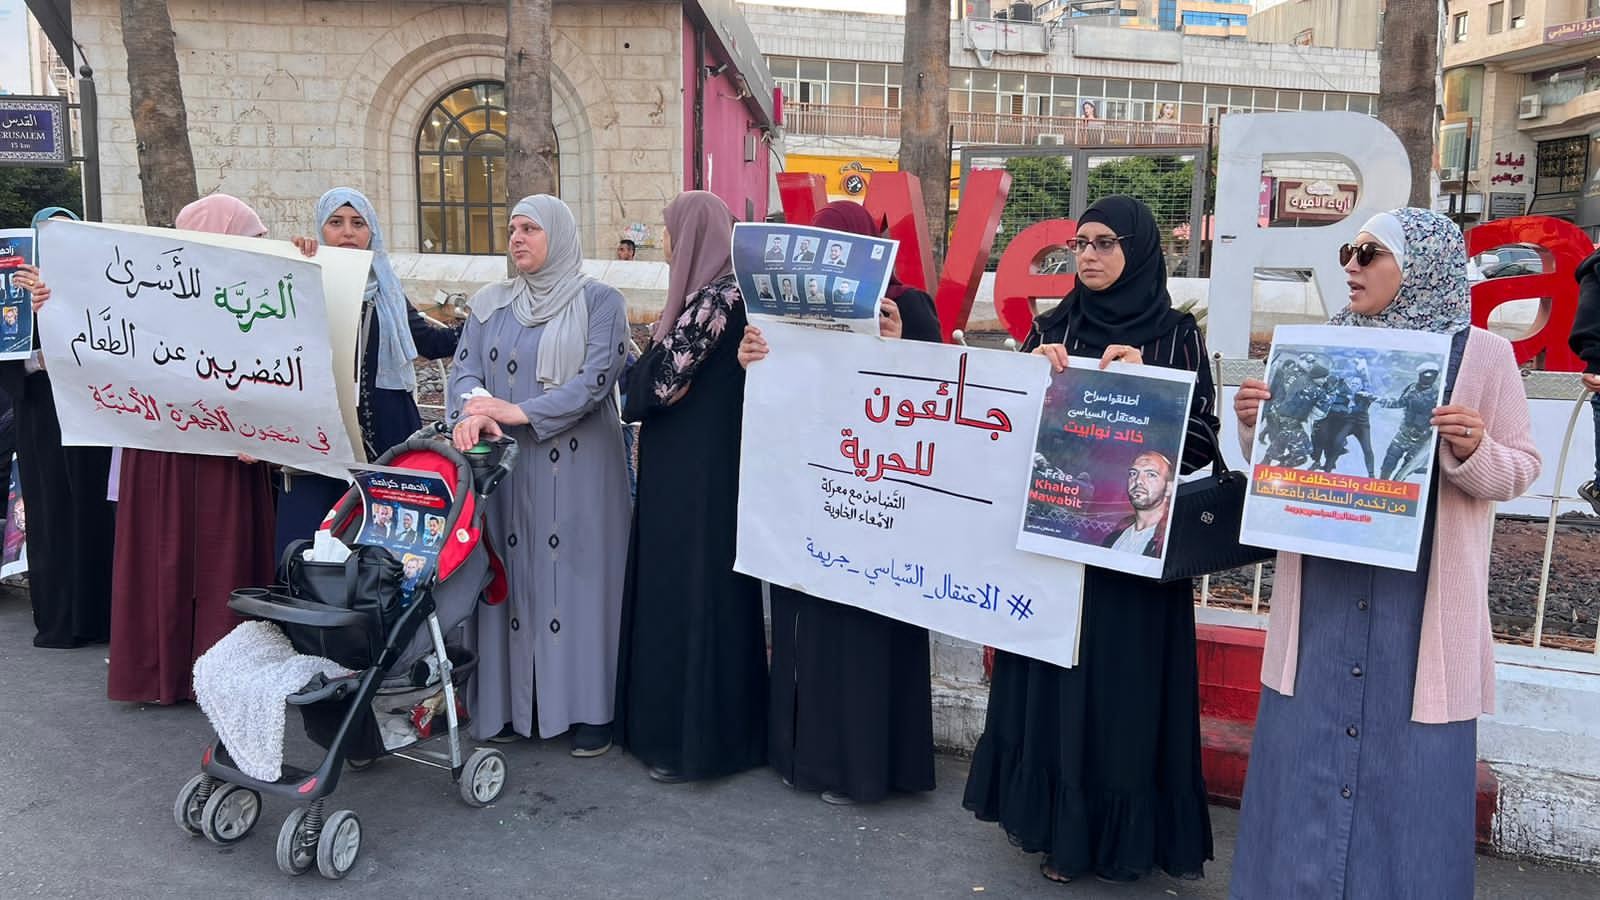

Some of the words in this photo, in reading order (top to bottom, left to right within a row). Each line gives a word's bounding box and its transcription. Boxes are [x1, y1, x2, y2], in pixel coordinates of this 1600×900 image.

[2, 113, 38, 128] القدس
[0, 131, 46, 140] ERUSALEM
[152, 340, 187, 366] عن
[864, 352, 1013, 441] جائعون
[1083, 390, 1108, 404] سراح
[1107, 410, 1150, 425] المعتقل
[307, 426, 331, 455] في
[1114, 429, 1144, 444] خالد
[839, 428, 935, 482] للحرية
[1044, 468, 1073, 482] Free
[1299, 473, 1360, 492] واختطاف
[821, 477, 848, 498] معركة
[1035, 479, 1080, 496] Khaled
[1307, 486, 1353, 506] السلطة
[1363, 480, 1408, 496] اعتقال
[848, 488, 863, 506] مع
[1029, 489, 1083, 508] Nawabit
[1354, 496, 1387, 511] تخدم
[823, 500, 857, 520] الخاوية
[1388, 501, 1407, 513] من
